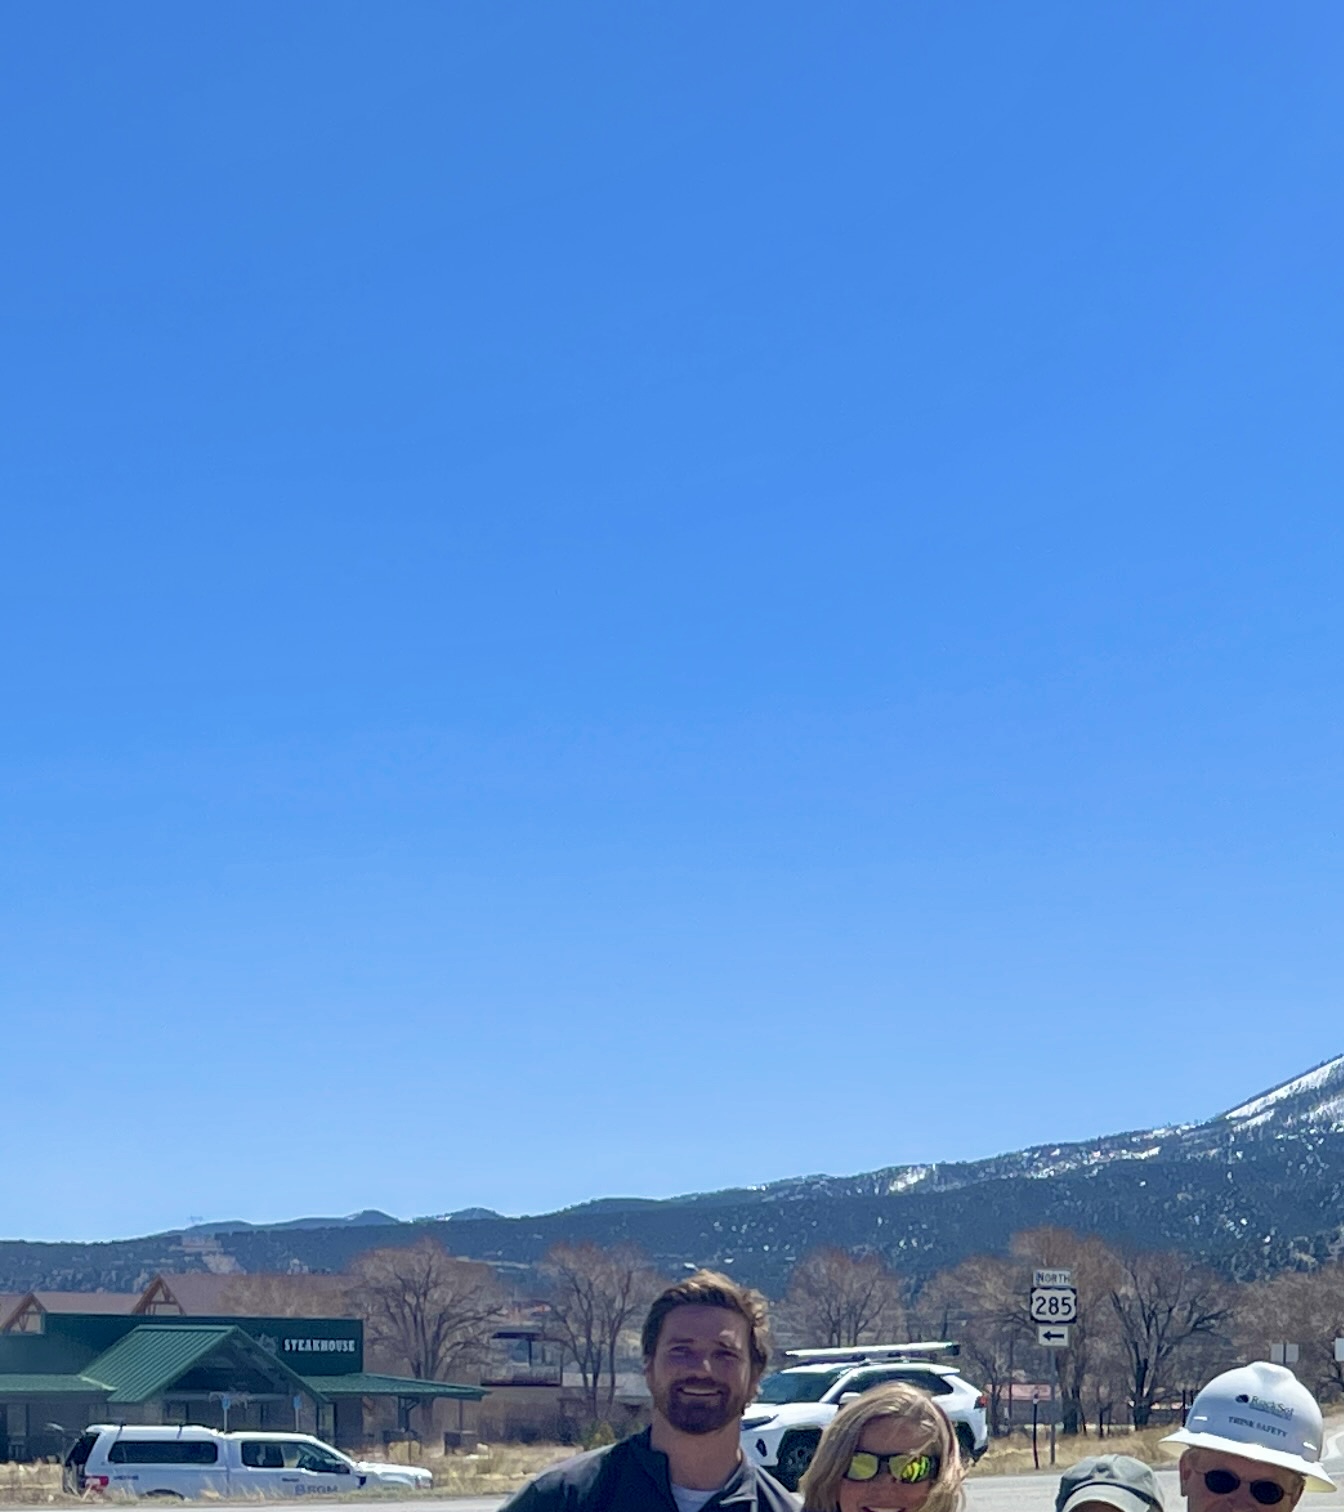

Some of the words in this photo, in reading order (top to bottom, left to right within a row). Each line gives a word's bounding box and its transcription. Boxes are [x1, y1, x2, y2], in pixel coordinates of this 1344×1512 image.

[1036, 1272, 1071, 1283] NORTH
[1036, 1296, 1072, 1315] 285
[284, 1339, 355, 1352] STEAKHOUSE
[1256, 1422, 1288, 1437] SAFETY
